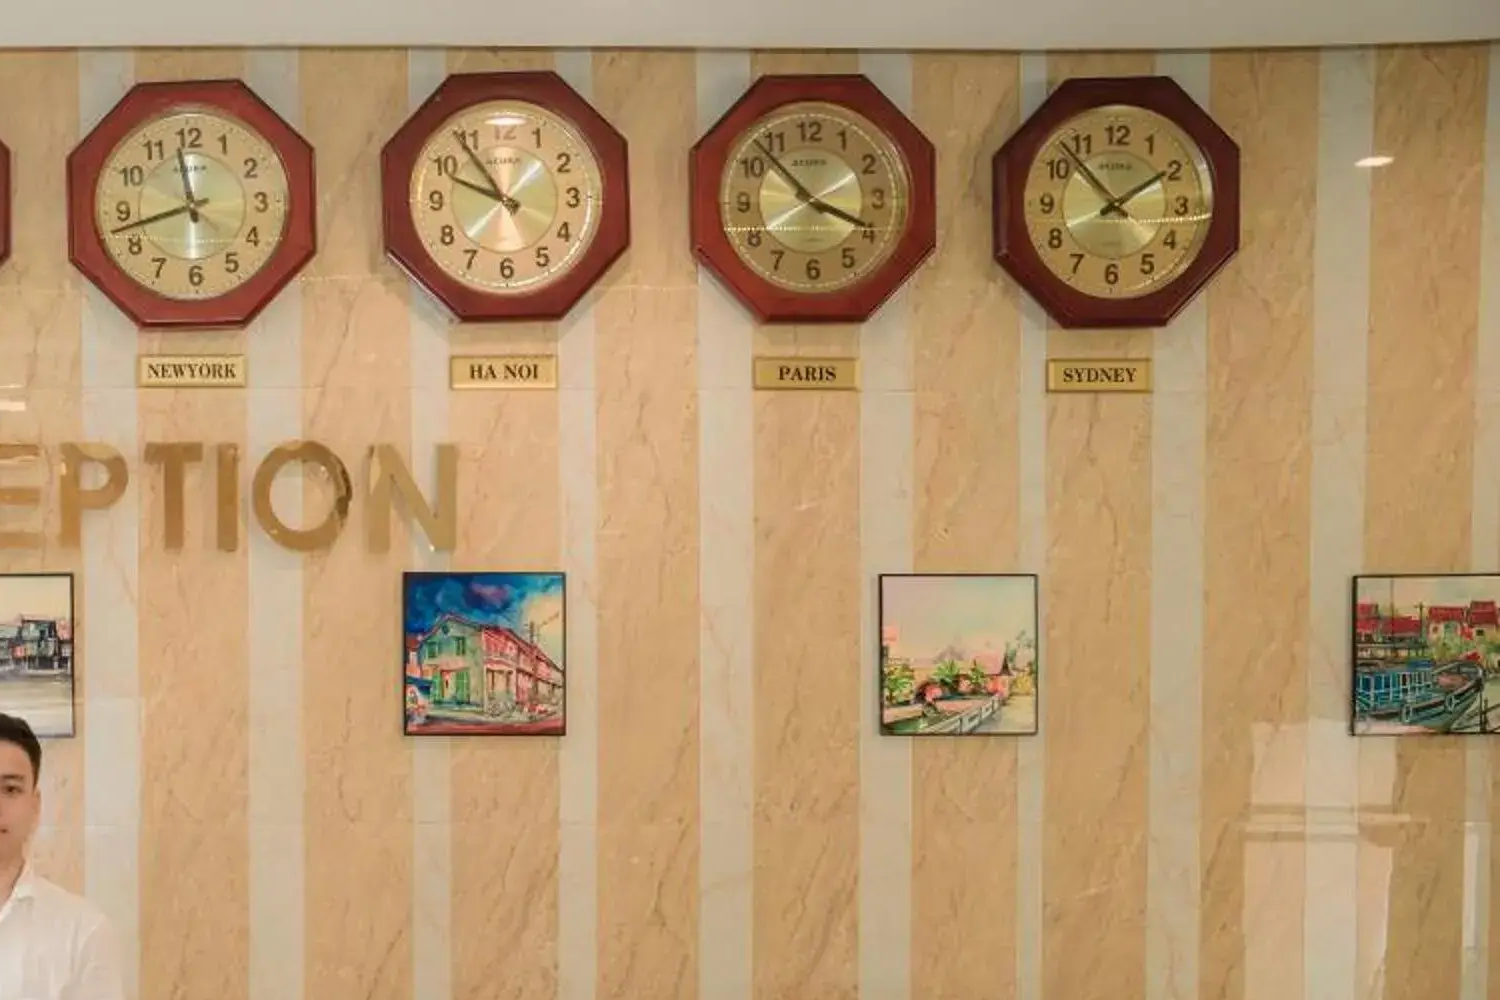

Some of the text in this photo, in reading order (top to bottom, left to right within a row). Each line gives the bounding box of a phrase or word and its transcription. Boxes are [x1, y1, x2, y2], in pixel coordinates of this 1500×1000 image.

[176, 127, 202, 149] 12
[532, 127, 542, 148] 1
[765, 132, 785, 151] 11
[797, 122, 823, 142] 12
[837, 130, 848, 150] 1
[1104, 125, 1131, 146] 12
[143, 140, 164, 160] 11
[218, 134, 228, 155] 1
[1072, 134, 1092, 154] 11
[1145, 135, 1155, 155] 1
[244, 158, 258, 178] 2
[434, 155, 457, 176] 10
[556, 153, 571, 173] 2
[740, 157, 764, 178] 10
[861, 153, 877, 174] 2
[1046, 159, 1069, 180] 10
[1167, 160, 1182, 181] 2
[120, 165, 143, 186] 10
[255, 192, 269, 212] 3
[429, 190, 444, 210] 9
[566, 187, 580, 208] 3
[736, 192, 750, 212] 9
[871, 189, 885, 209] 3
[1040, 193, 1054, 214] 9
[1174, 195, 1189, 216] 3
[115, 201, 130, 221] 9
[245, 226, 259, 246] 4
[440, 225, 454, 245] 8
[557, 222, 571, 242] 4
[747, 227, 762, 248] 8
[861, 223, 876, 244] 4
[1048, 228, 1063, 249] 8
[1163, 229, 1176, 250] 4
[128, 234, 142, 254] 8
[225, 252, 239, 272] 5
[464, 249, 479, 269] 7
[536, 247, 549, 267] 5
[770, 250, 784, 270] 7
[842, 248, 856, 269] 5
[1070, 253, 1084, 274] 7
[1140, 254, 1155, 275] 5
[152, 258, 167, 278] 7
[189, 266, 203, 286] 6
[500, 258, 514, 278] 6
[806, 259, 821, 280] 6
[1104, 263, 1118, 284] 6
[148, 364, 236, 379] NEWYORK
[778, 366, 836, 381] PARIS
[1063, 368, 1136, 383] SYDNEY
